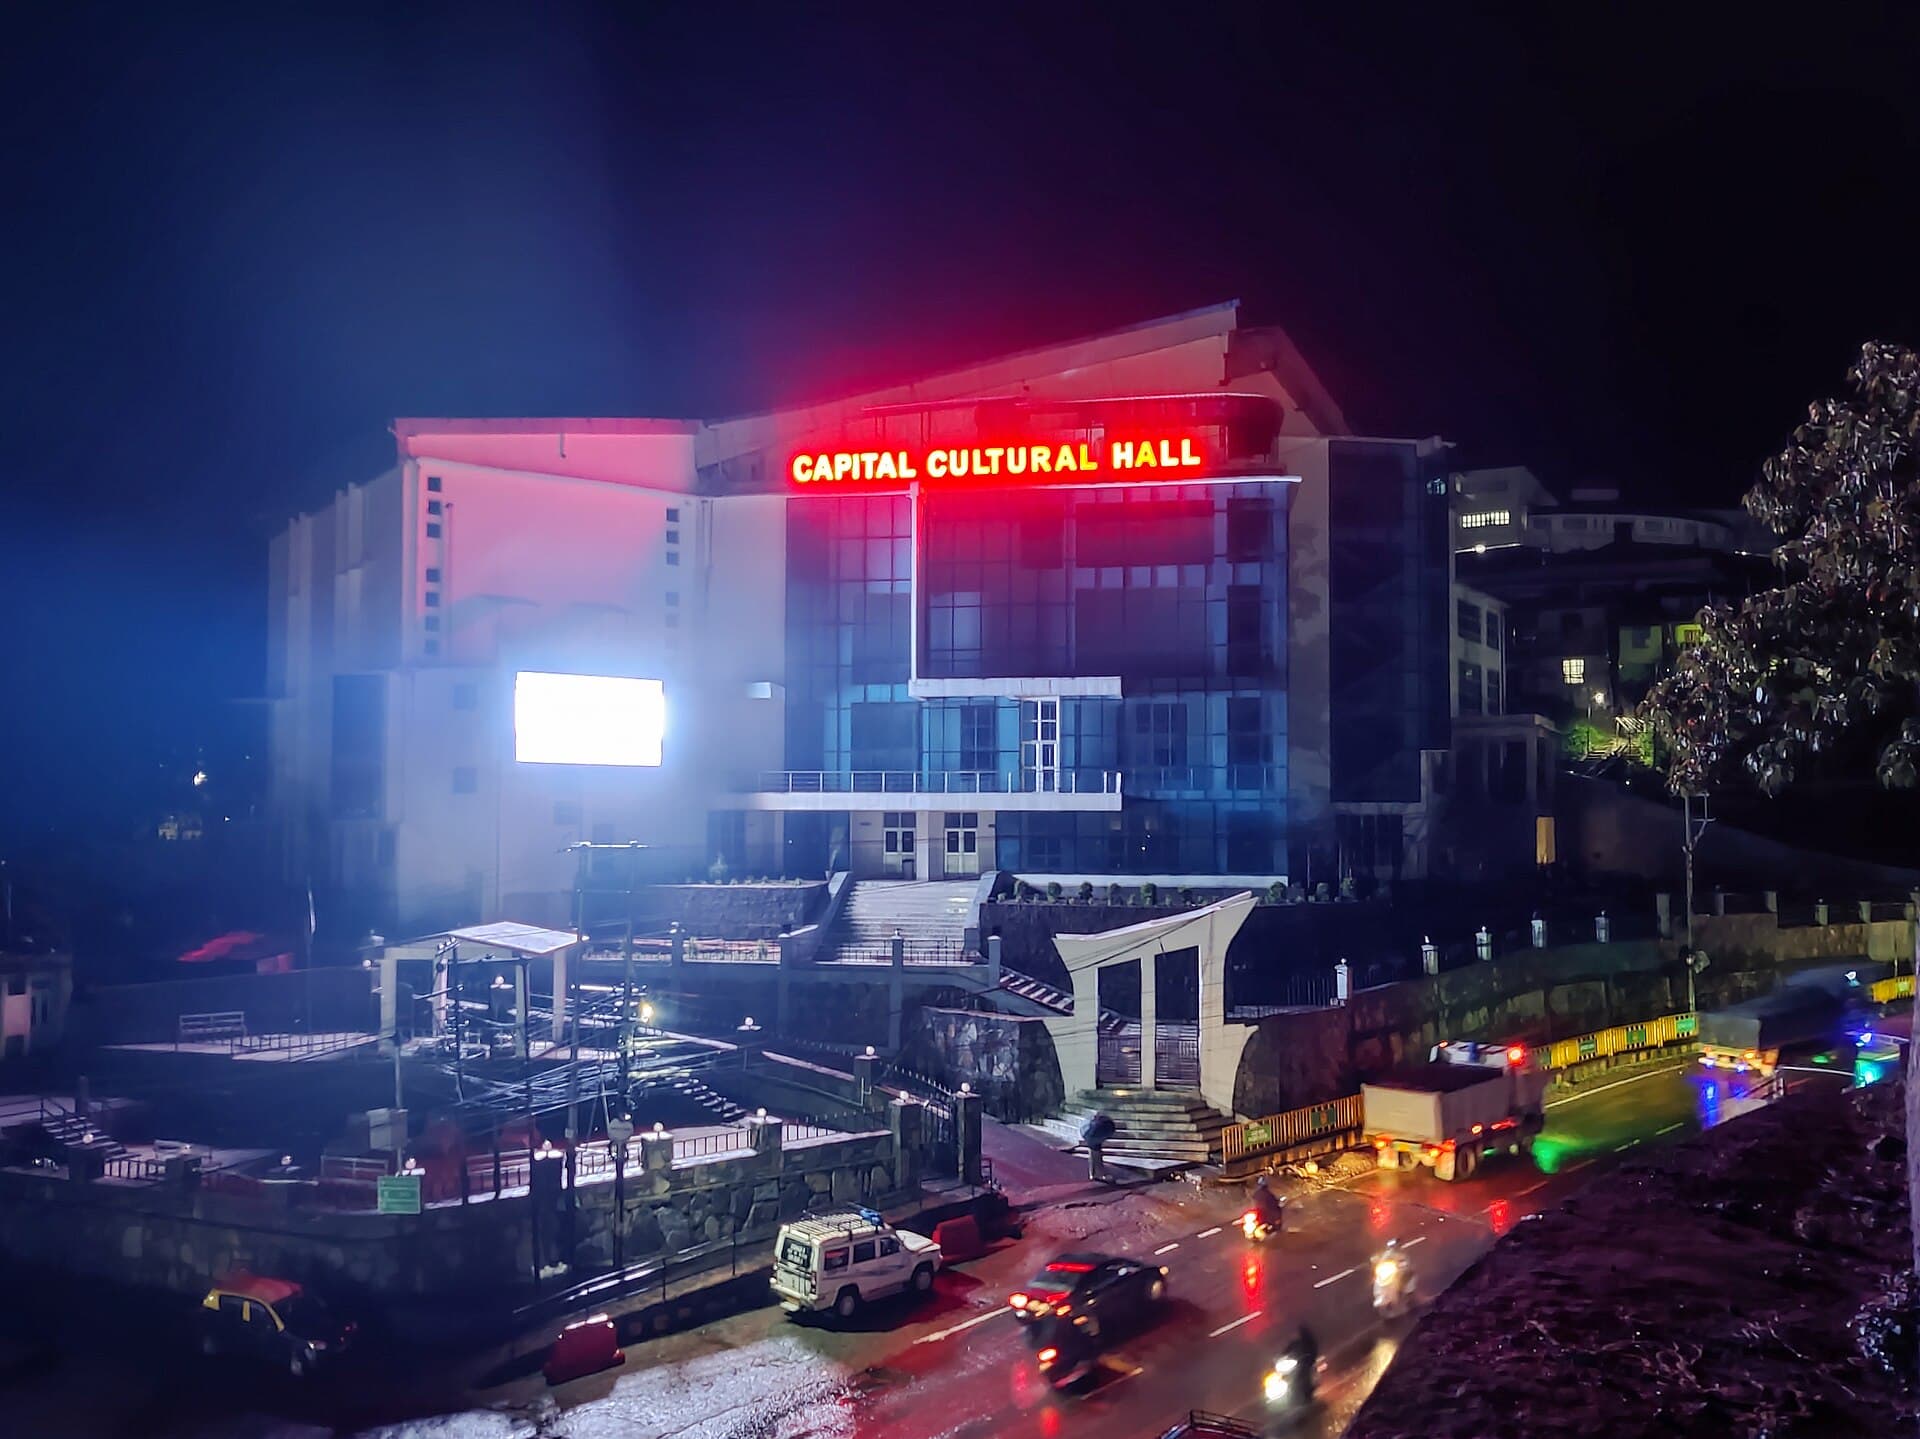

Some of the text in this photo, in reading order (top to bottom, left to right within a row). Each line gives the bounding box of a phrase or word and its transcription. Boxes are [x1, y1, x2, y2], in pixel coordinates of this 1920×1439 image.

[792, 439, 1201, 482] CAPITAL CULTURAL HALL
